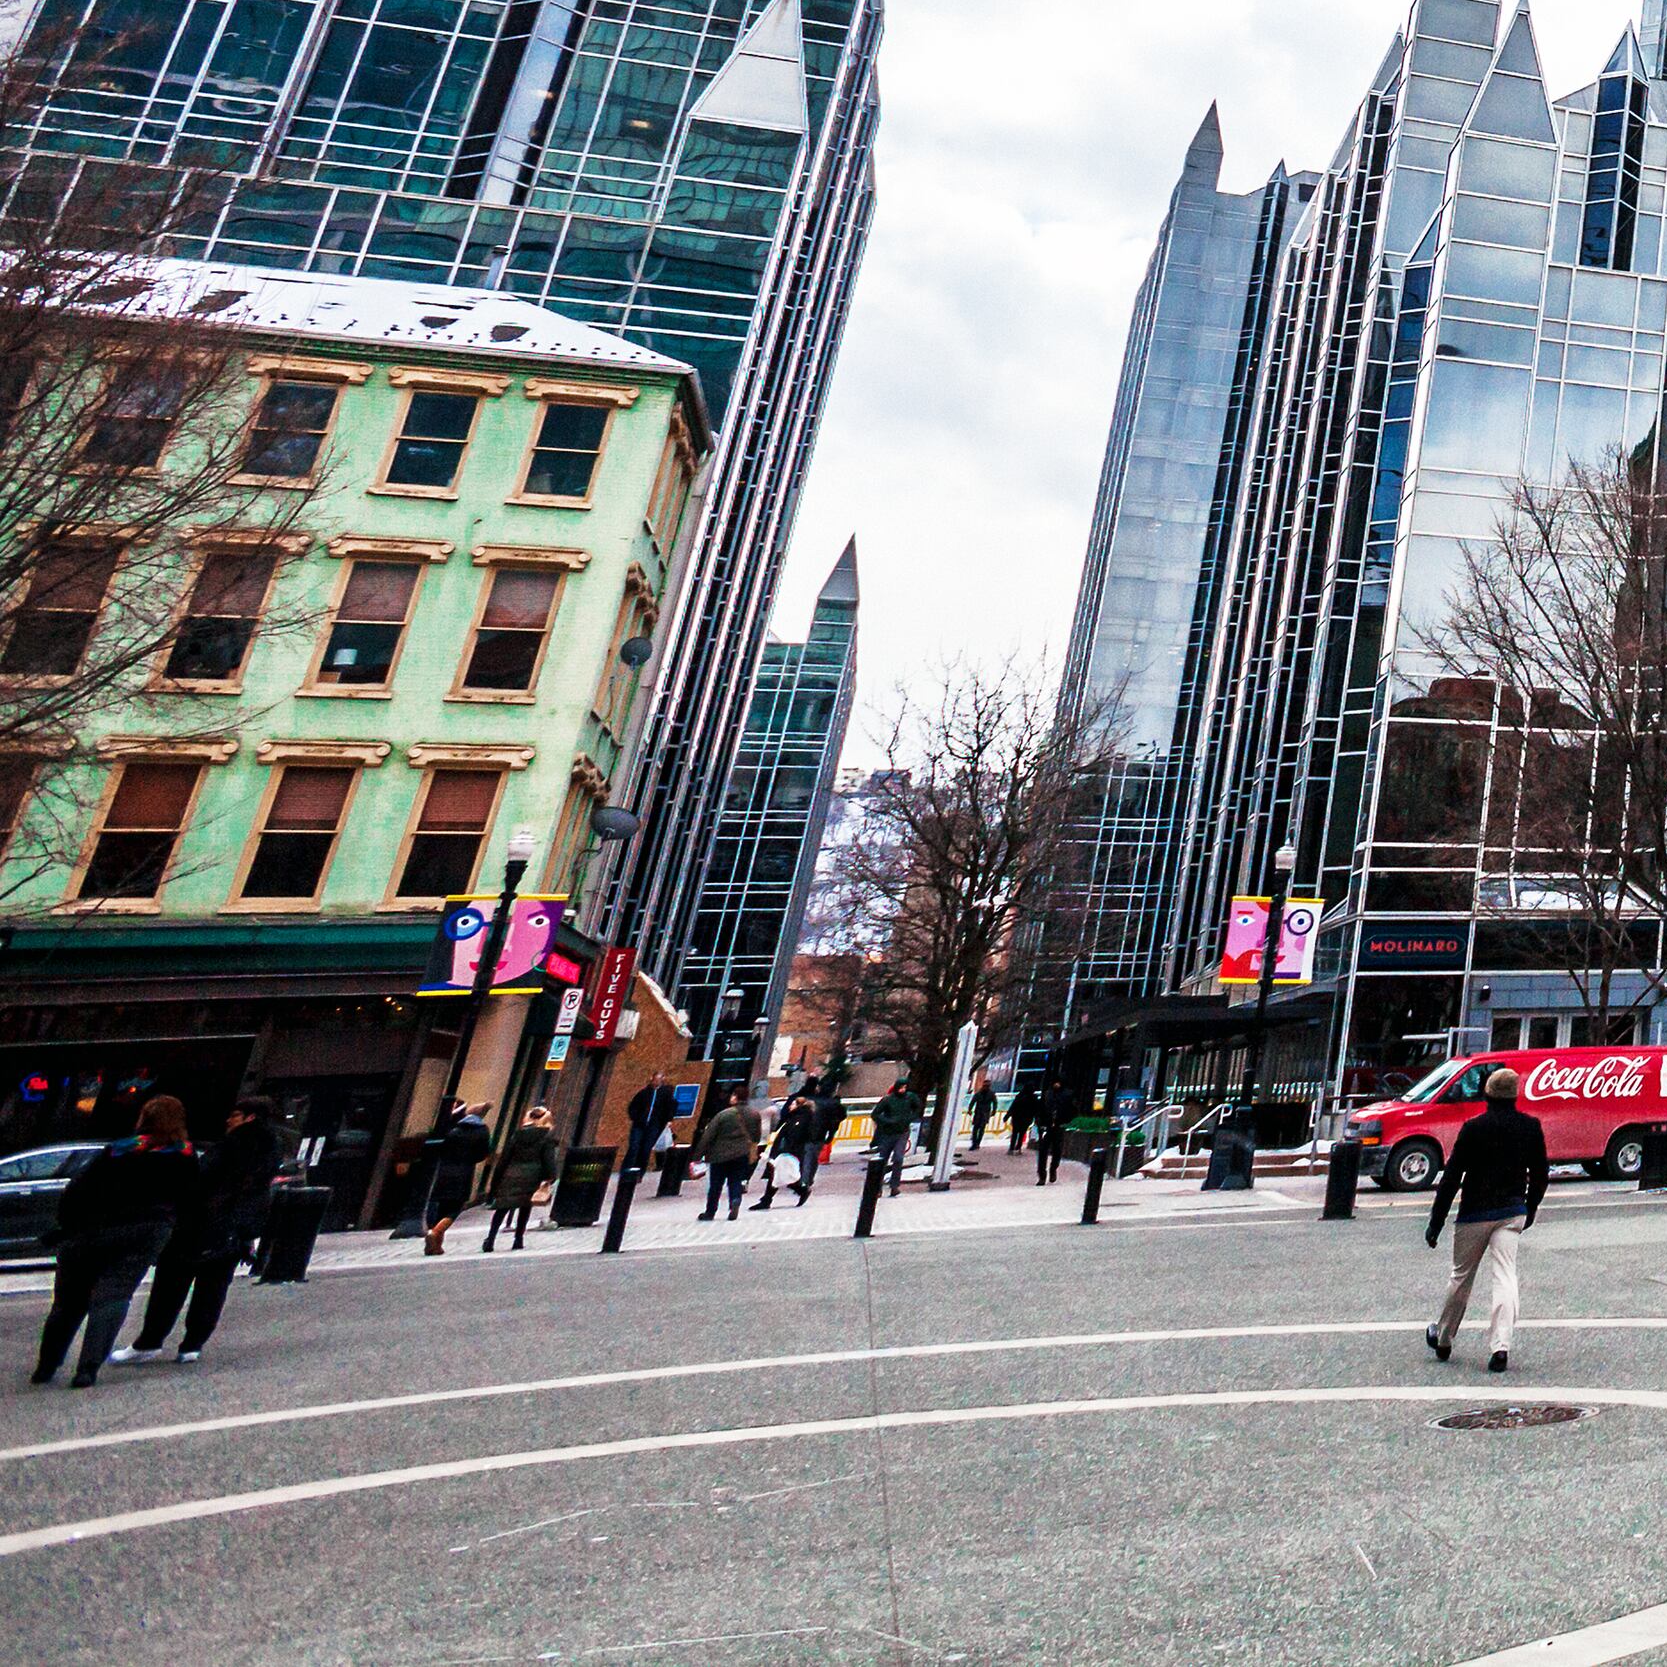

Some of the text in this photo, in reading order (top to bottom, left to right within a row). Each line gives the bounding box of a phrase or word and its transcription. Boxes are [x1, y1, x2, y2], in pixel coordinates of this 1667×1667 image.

[1370, 940, 1458, 953] MOLINARO
[595, 953, 626, 1040] FIVE GUYS
[1525, 1056, 1652, 1101] Coca-Cola
